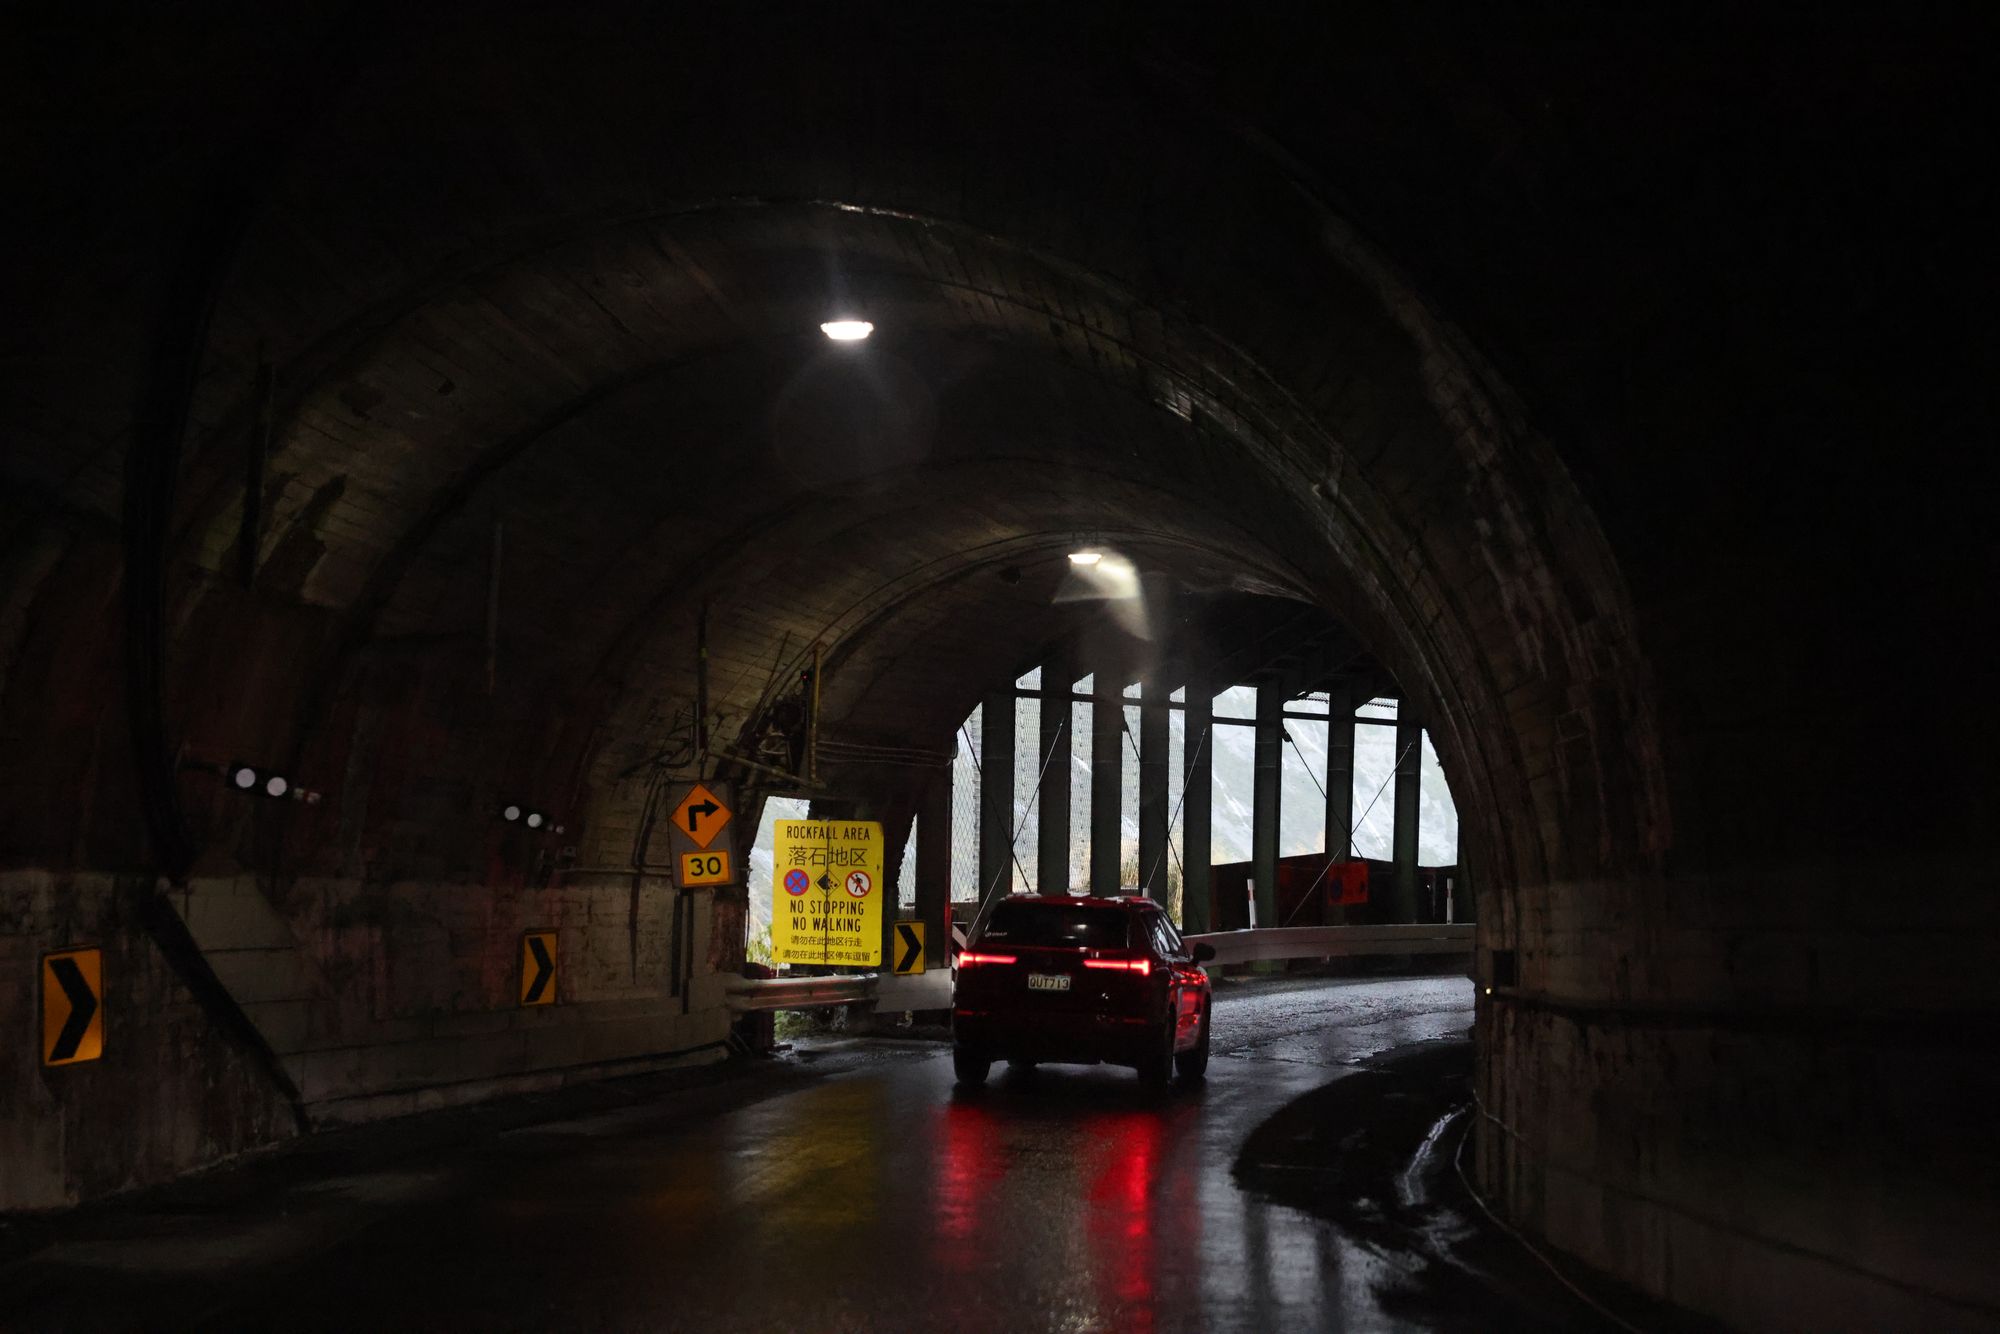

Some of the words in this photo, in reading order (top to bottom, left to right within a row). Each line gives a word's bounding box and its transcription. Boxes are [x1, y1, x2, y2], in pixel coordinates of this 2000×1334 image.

[787, 825, 838, 840] ROCKFALL
[843, 827, 870, 841] AREA
[788, 845, 867, 867] 落石地区
[690, 857, 721, 876] 30
[790, 899, 803, 913] NO
[810, 900, 864, 915] STOPPING
[793, 916, 806, 930] NO
[813, 917, 861, 932] WALKING
[790, 935, 862, 947] 请勿在此地区行走
[1030, 976, 1069, 989] QUT713
